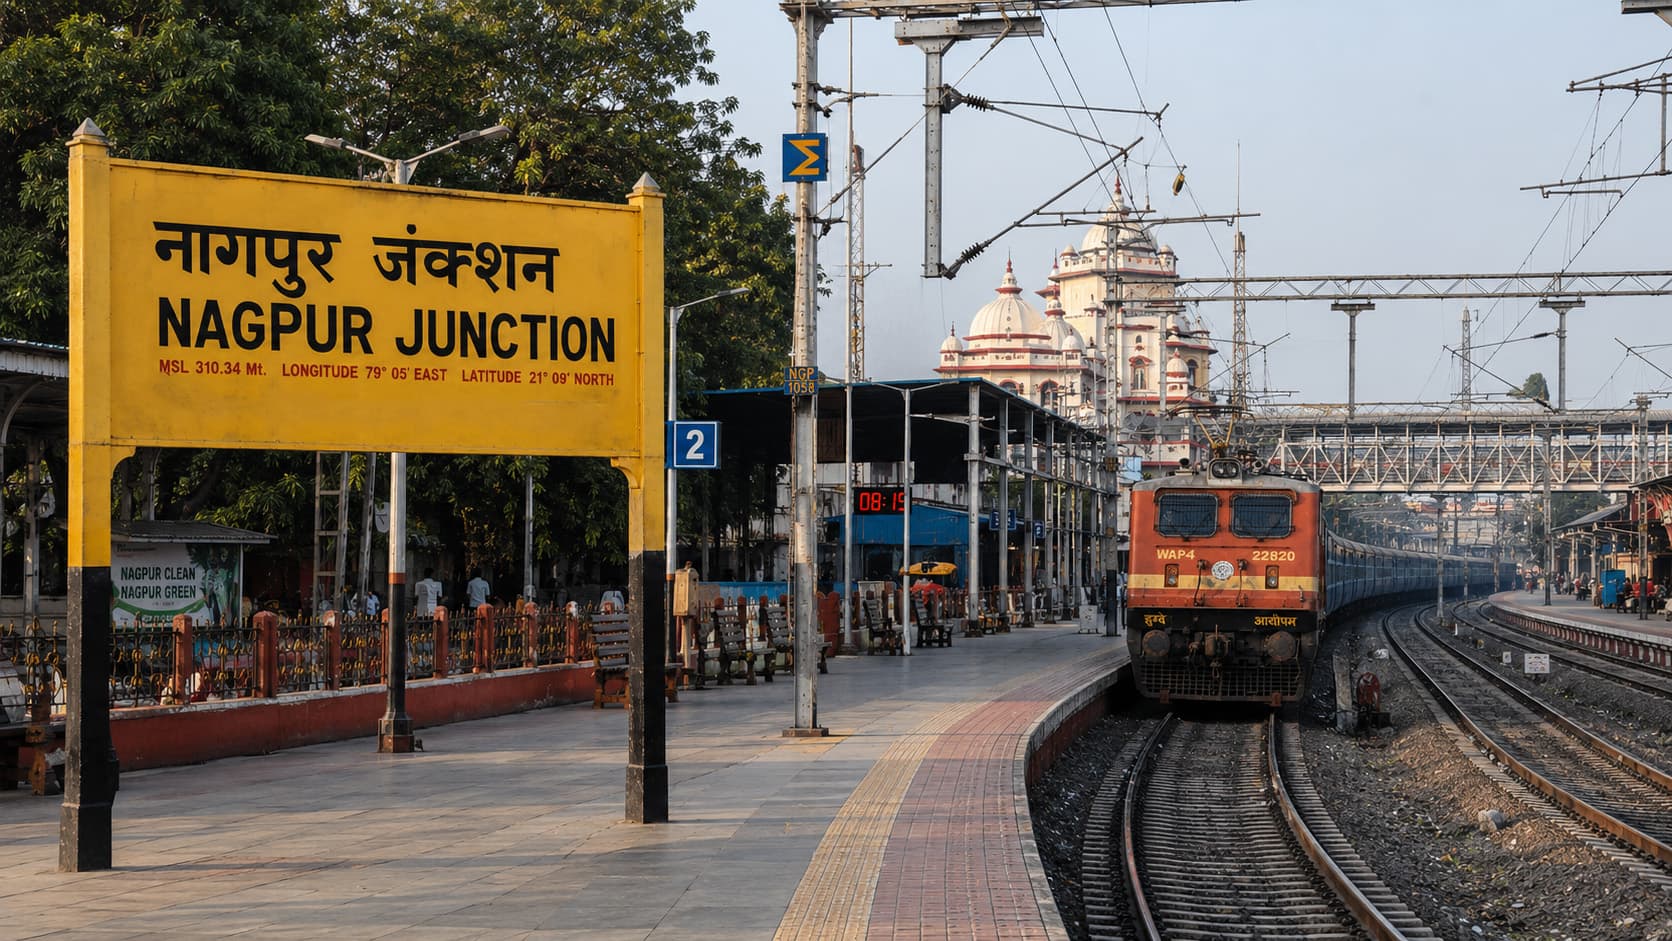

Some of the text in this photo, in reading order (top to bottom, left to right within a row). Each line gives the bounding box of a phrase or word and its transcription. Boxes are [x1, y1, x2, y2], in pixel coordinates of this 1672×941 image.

[153, 221, 561, 299] नागपुर जंक्शन
[158, 297, 615, 363] NAGPUR JUNCTION
[159, 358, 190, 377] MSL
[195, 360, 241, 376] 310.34
[246, 362, 267, 376] Mt.
[282, 363, 358, 379] LONGITUDE
[365, 365, 387, 380] 79°
[413, 367, 448, 382] EAST
[461, 369, 522, 384] LATITUDE
[529, 371, 549, 385] 21°
[574, 372, 614, 387] NORTH
[789, 367, 815, 381] NGP
[686, 429, 704, 460] 2
[1156, 549, 1195, 560] WAP4
[1252, 550, 1296, 561] 22820
[121, 566, 196, 580] NAGPUR CLEAN
[121, 585, 196, 599] NAGPUR GREEN
